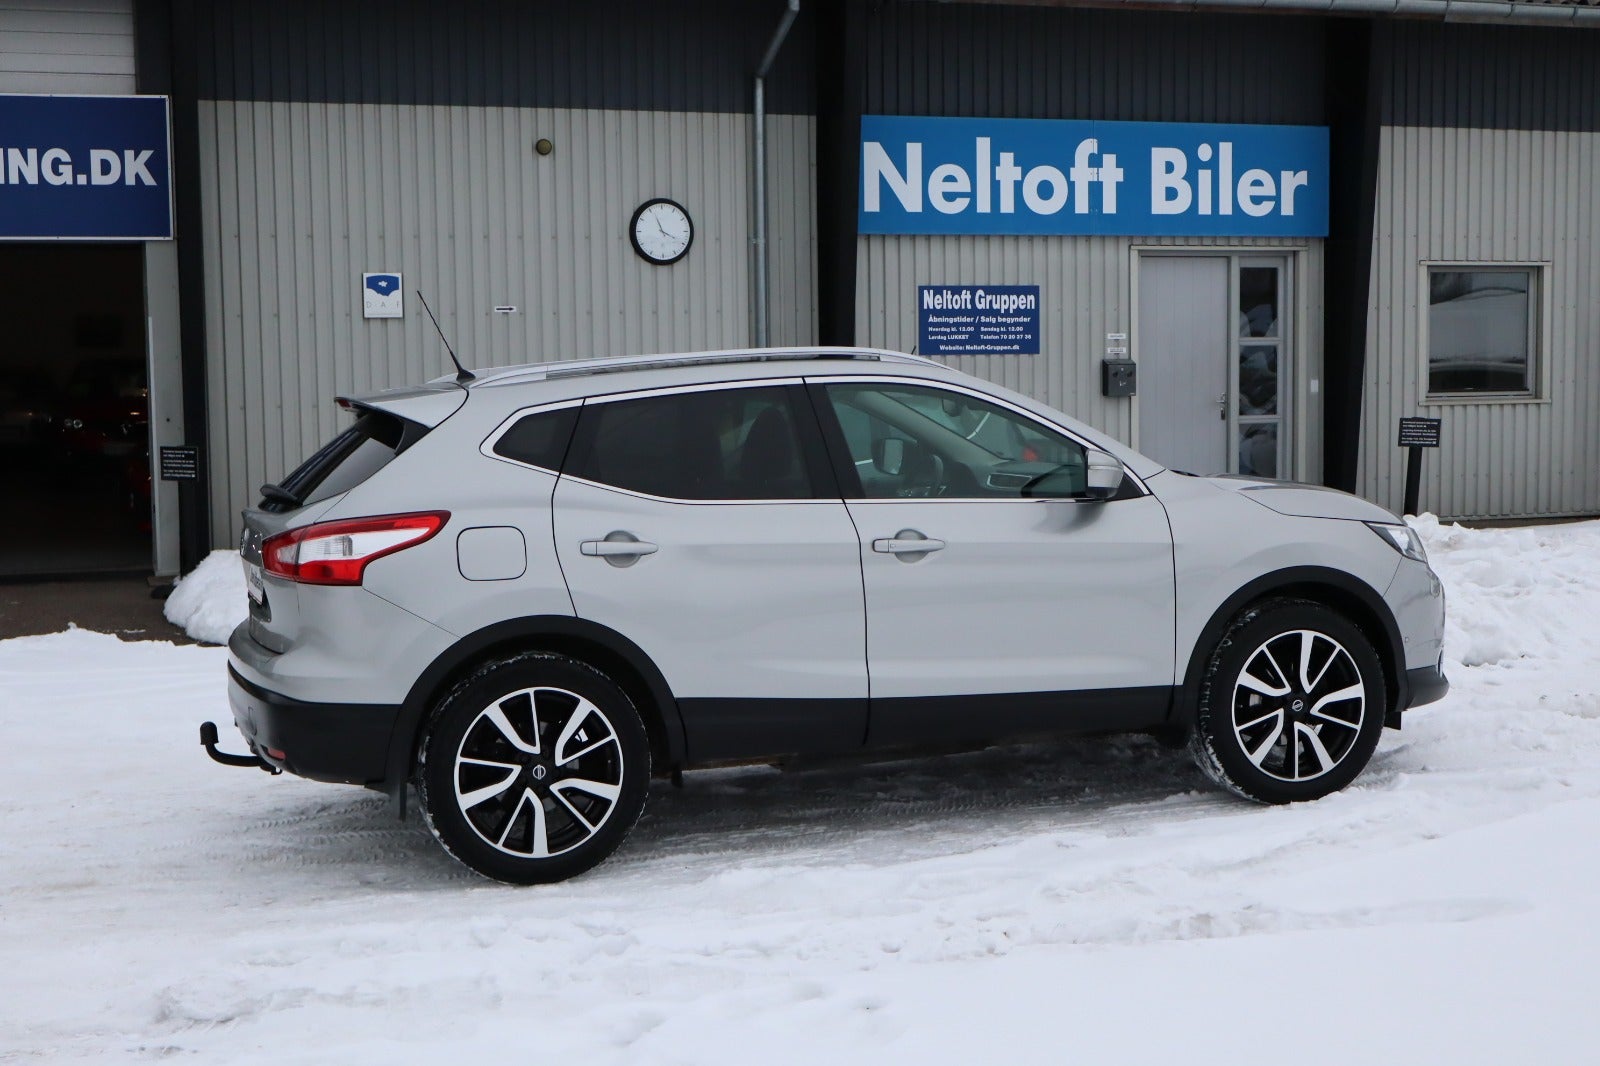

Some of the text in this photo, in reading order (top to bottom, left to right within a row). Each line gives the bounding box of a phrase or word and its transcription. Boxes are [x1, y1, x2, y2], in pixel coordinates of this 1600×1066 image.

[863, 136, 1308, 217] Neltoft Biler
[923, 289, 1035, 313] Neltoft Gruppen
[928, 314, 974, 323] Åbningstider
[980, 315, 996, 323] Salg
[997, 315, 1031, 323] begynder
